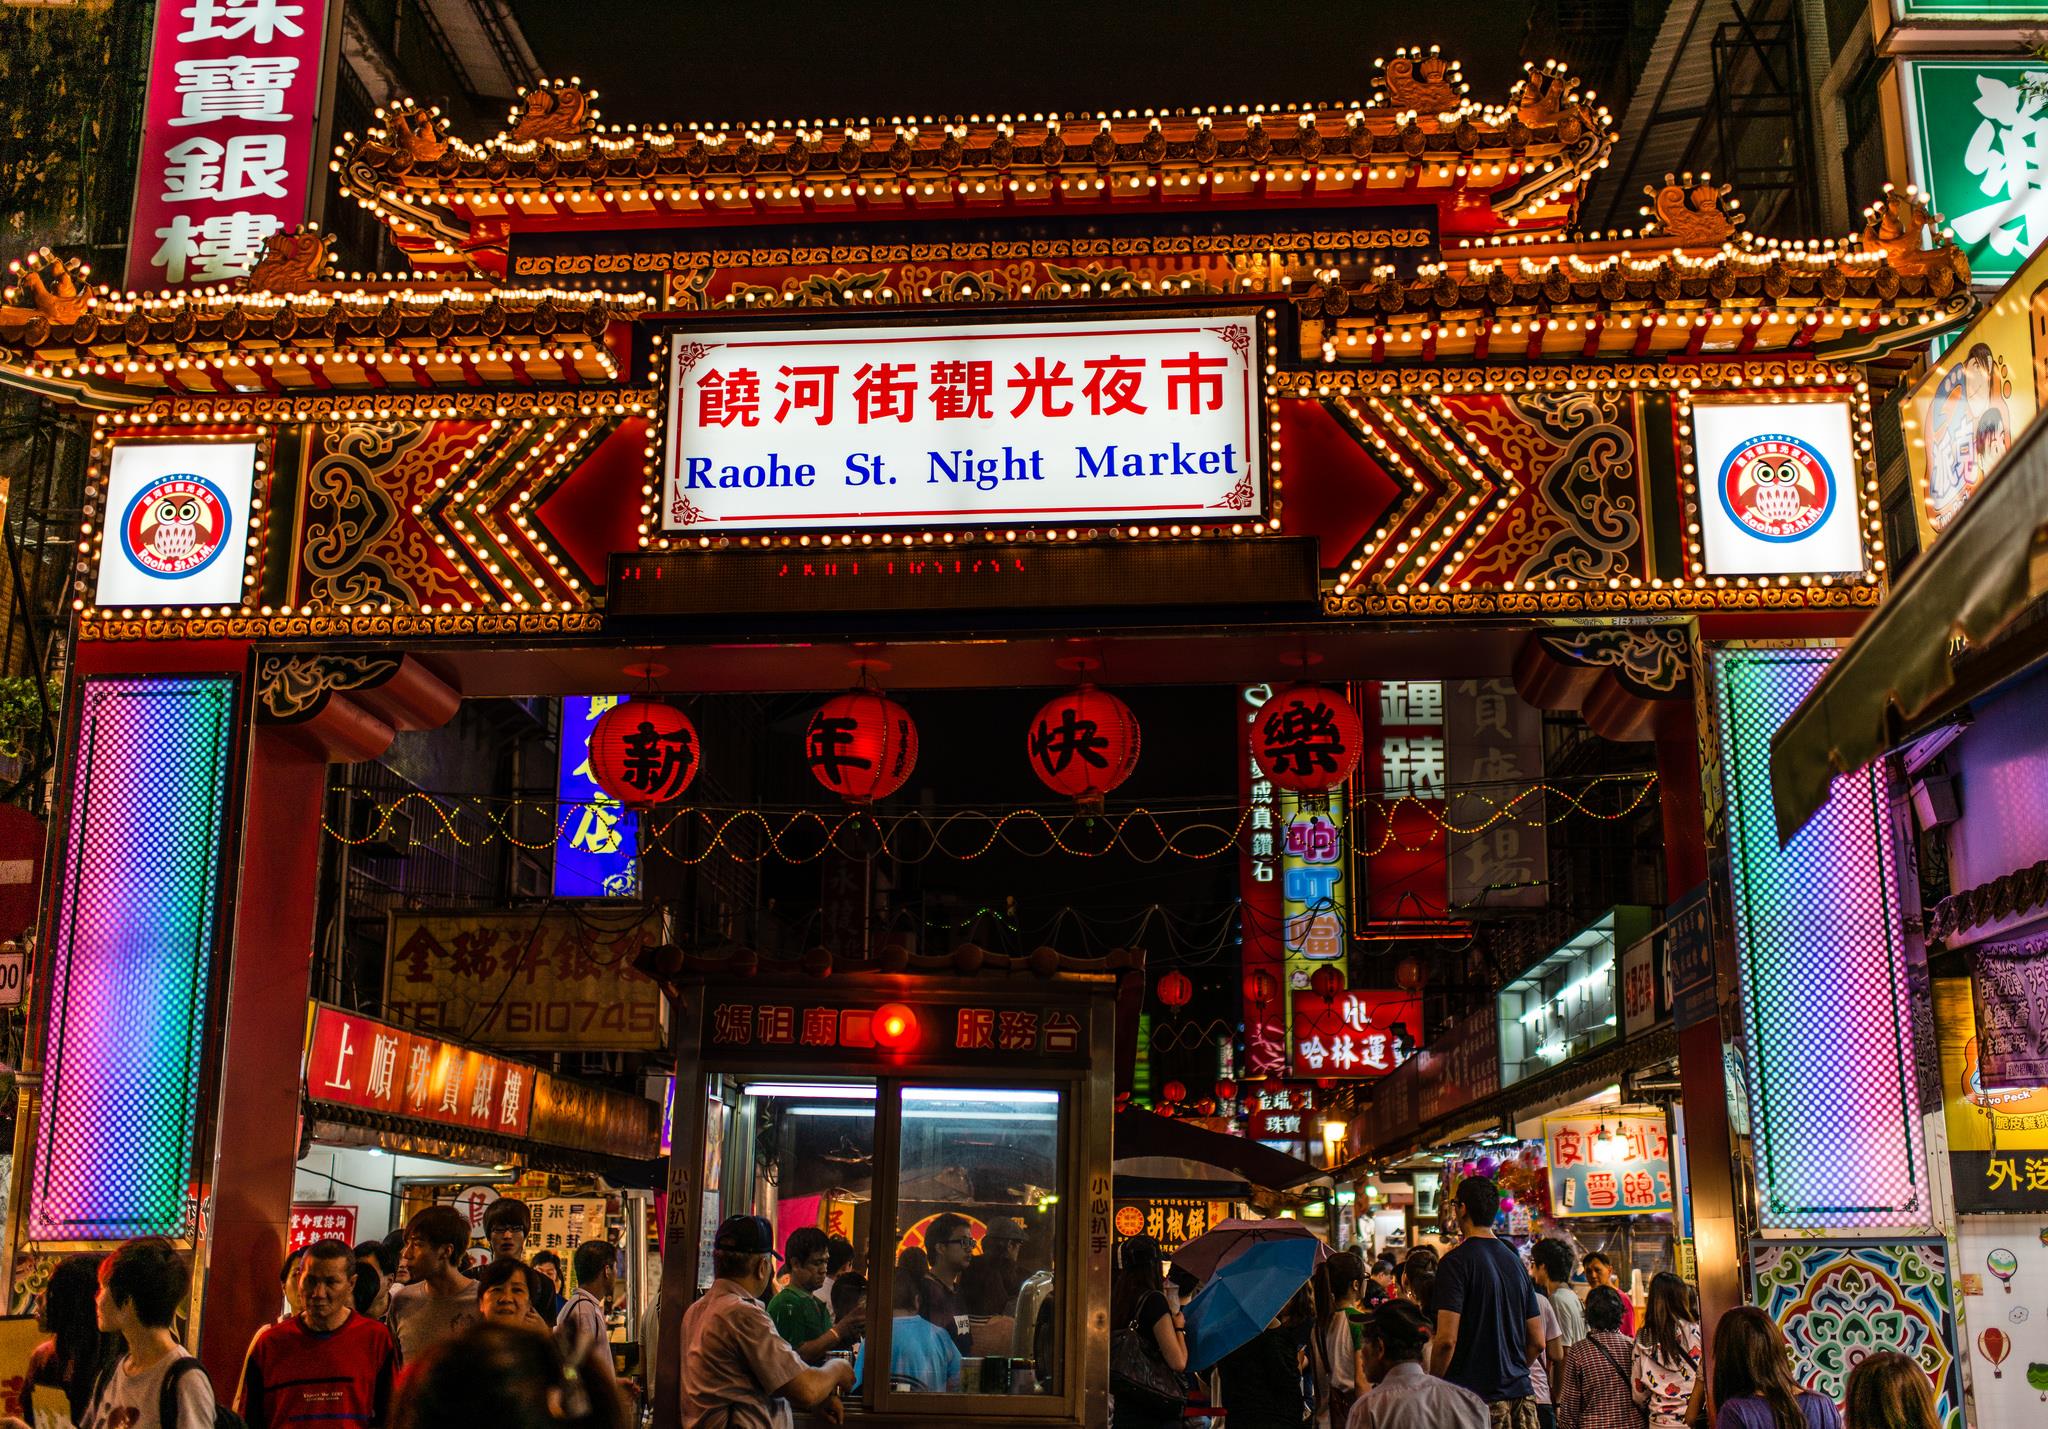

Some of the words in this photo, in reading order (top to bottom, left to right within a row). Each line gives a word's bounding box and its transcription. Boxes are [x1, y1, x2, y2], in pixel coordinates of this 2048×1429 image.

[151, 0, 304, 284] 珠寶銀樓
[697, 350, 1229, 428] 饒河街觀光夜市
[685, 453, 816, 490] Raohe
[844, 452, 897, 487] St.
[926, 447, 1044, 491] Night
[1075, 442, 1237, 479] Market
[1741, 510, 1781, 535] Raohe
[138, 548, 173, 571] Raohe
[621, 721, 695, 800] 新
[806, 711, 873, 786] 年
[1034, 709, 1110, 779] 快
[1263, 701, 1345, 775] 樂
[477, 1001, 657, 1033] 7610745
[956, 1007, 1081, 1052] 服務台
[325, 1021, 523, 1127] 上順珠寶銀樓
[2003, 1090, 2031, 1104] Peck
[1265, 1114, 1302, 1134] 珠寶
[1986, 1157, 2048, 1192] 外送
[669, 1169, 689, 1245] 小心扒手
[1091, 1177, 1109, 1254] 小心扒手
[1146, 1207, 1206, 1242] 胡椒餅
